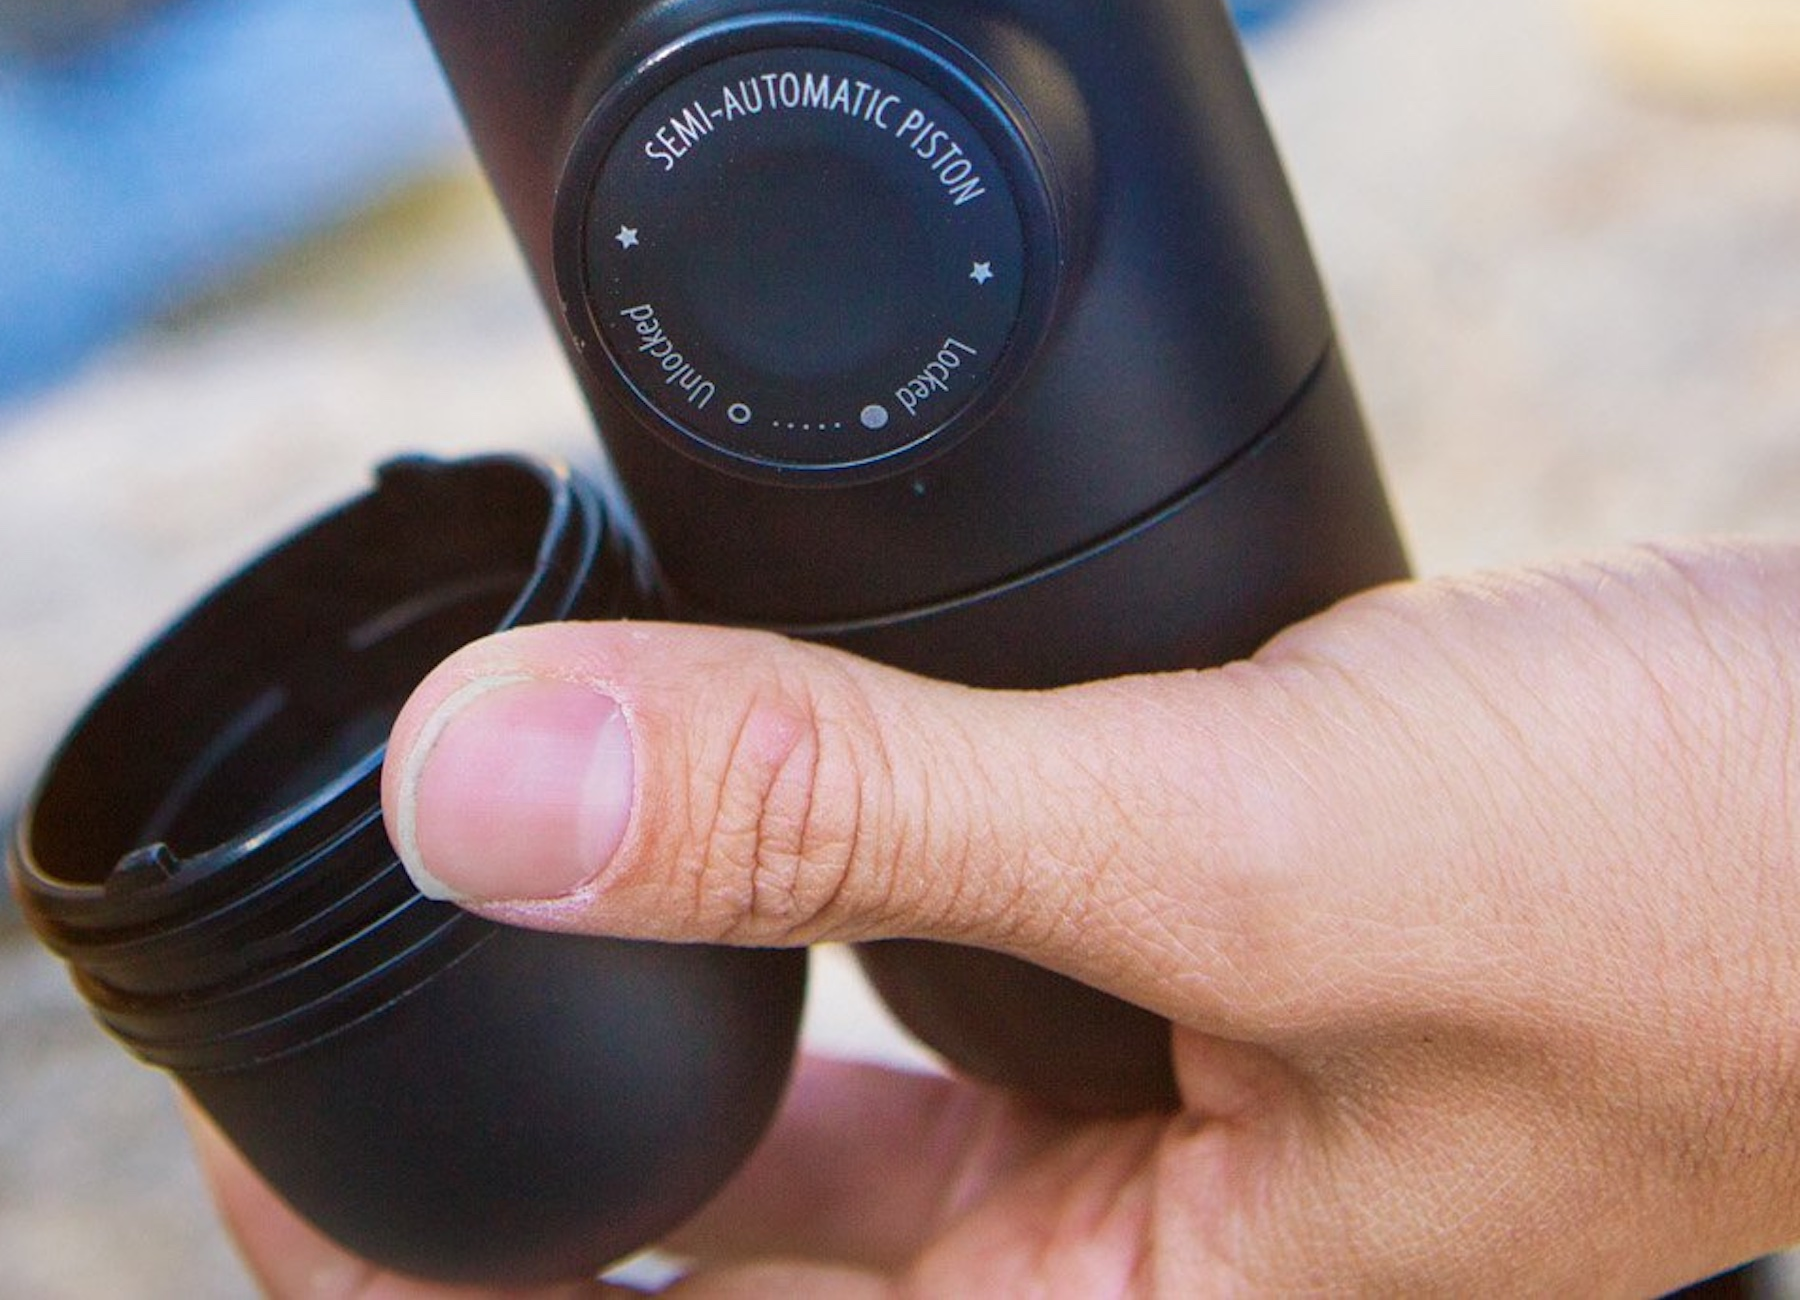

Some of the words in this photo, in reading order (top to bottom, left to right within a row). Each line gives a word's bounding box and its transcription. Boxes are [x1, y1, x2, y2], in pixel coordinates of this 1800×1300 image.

[644, 71, 901, 171] SEMI-AUTOMATIC
[895, 108, 986, 206] PISTON
[620, 303, 717, 409] Unlocked
[895, 337, 978, 416] Locked
